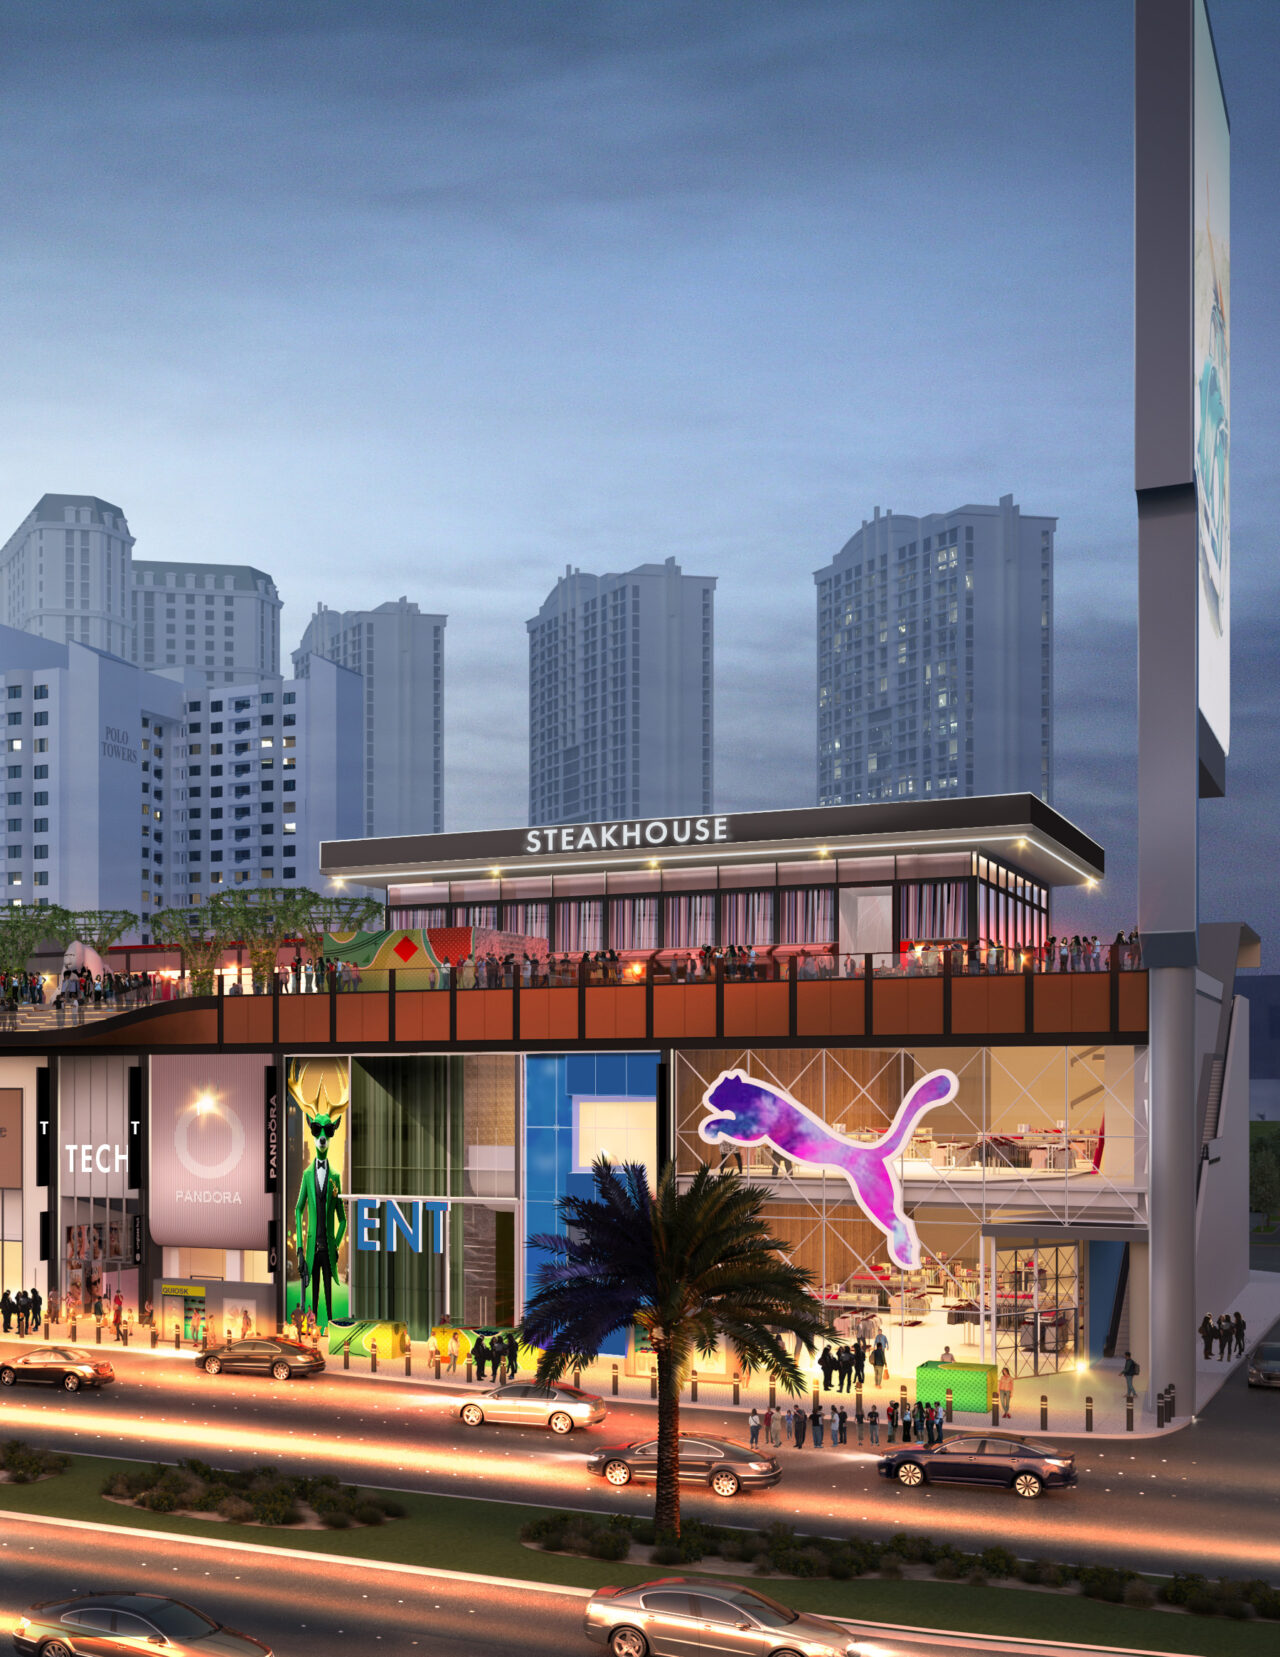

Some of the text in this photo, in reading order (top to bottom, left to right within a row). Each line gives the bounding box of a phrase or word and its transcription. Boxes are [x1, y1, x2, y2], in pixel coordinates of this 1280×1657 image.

[100, 726, 138, 764] POLO TOWERS
[526, 817, 728, 853] STEAKHOUSE
[39, 1121, 49, 1135] T
[130, 1121, 140, 1135] T
[268, 1094, 278, 1179] PANDORA
[65, 1144, 128, 1173] TECH
[175, 1190, 242, 1204] PANDORA
[357, 1198, 451, 1254] ENT
